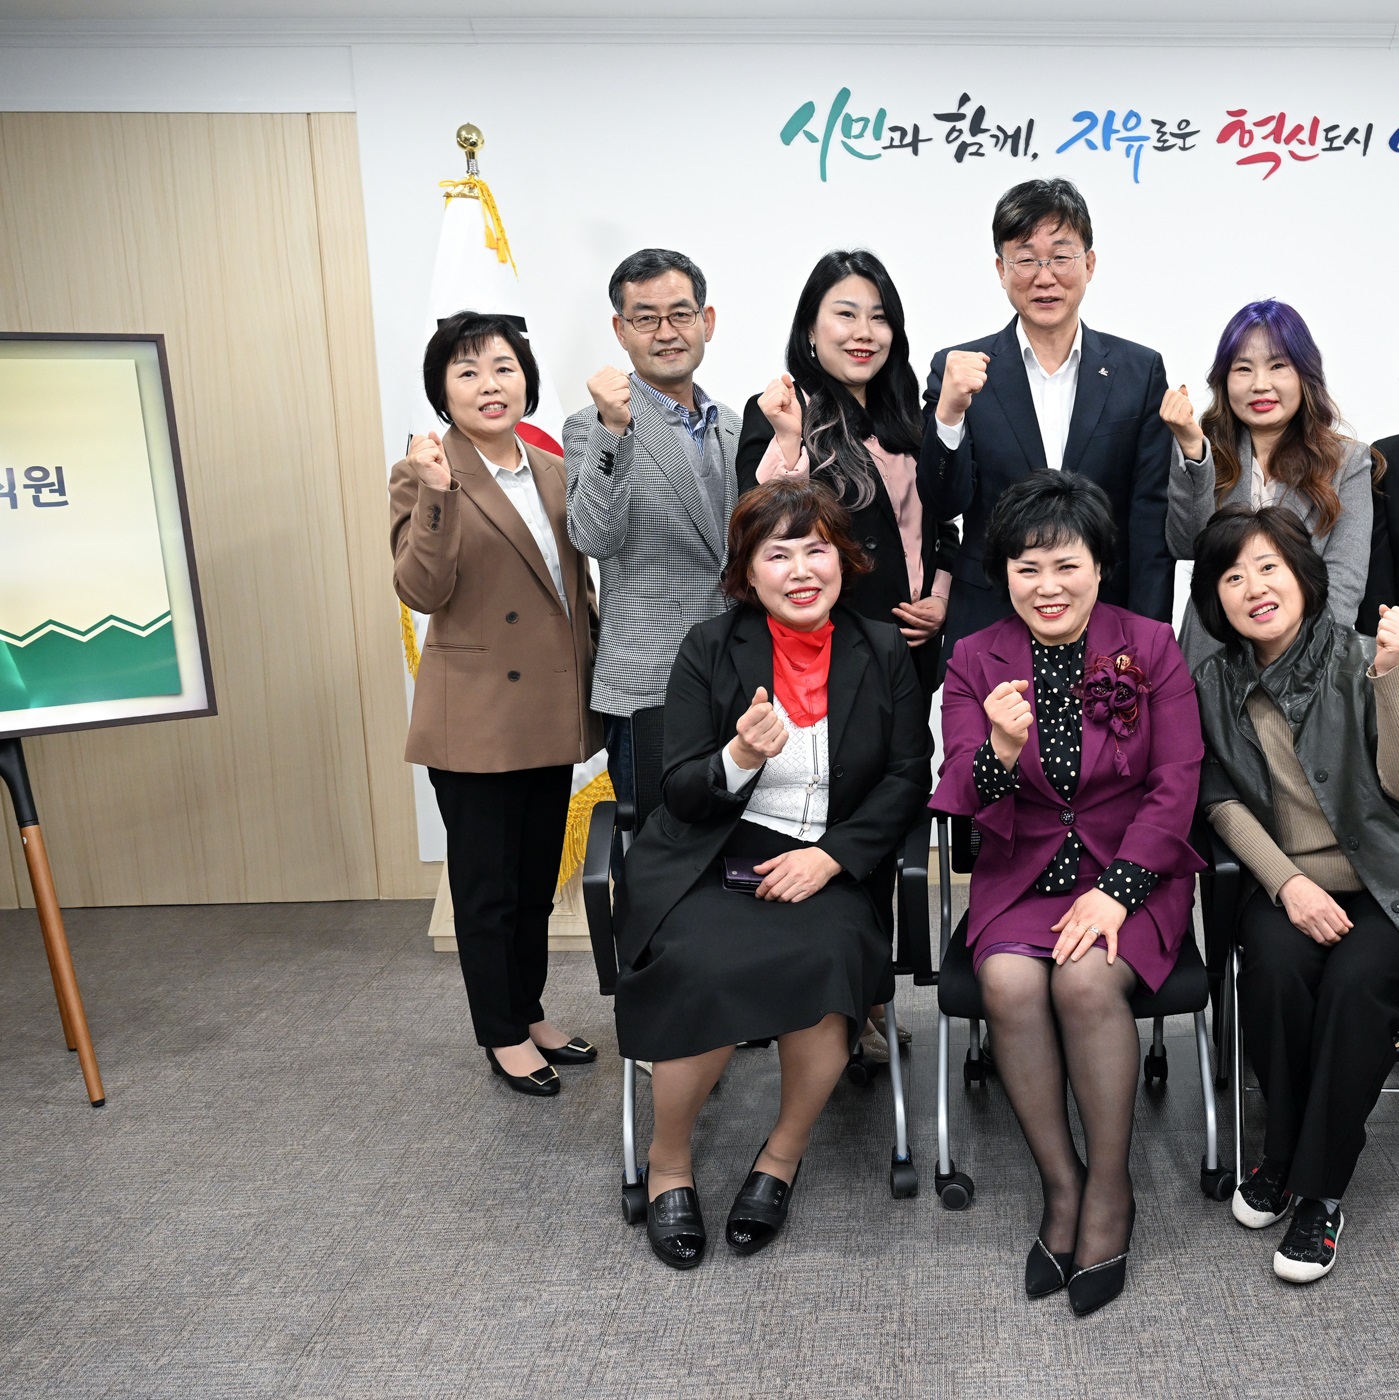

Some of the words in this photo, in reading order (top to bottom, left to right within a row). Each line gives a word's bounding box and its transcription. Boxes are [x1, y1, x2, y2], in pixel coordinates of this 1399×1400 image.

[779, 86, 934, 184] 시민과
[932, 91, 1041, 165] 함께,
[1055, 108, 1201, 185] 자유로운
[1215, 107, 1374, 181] 혁신도시
